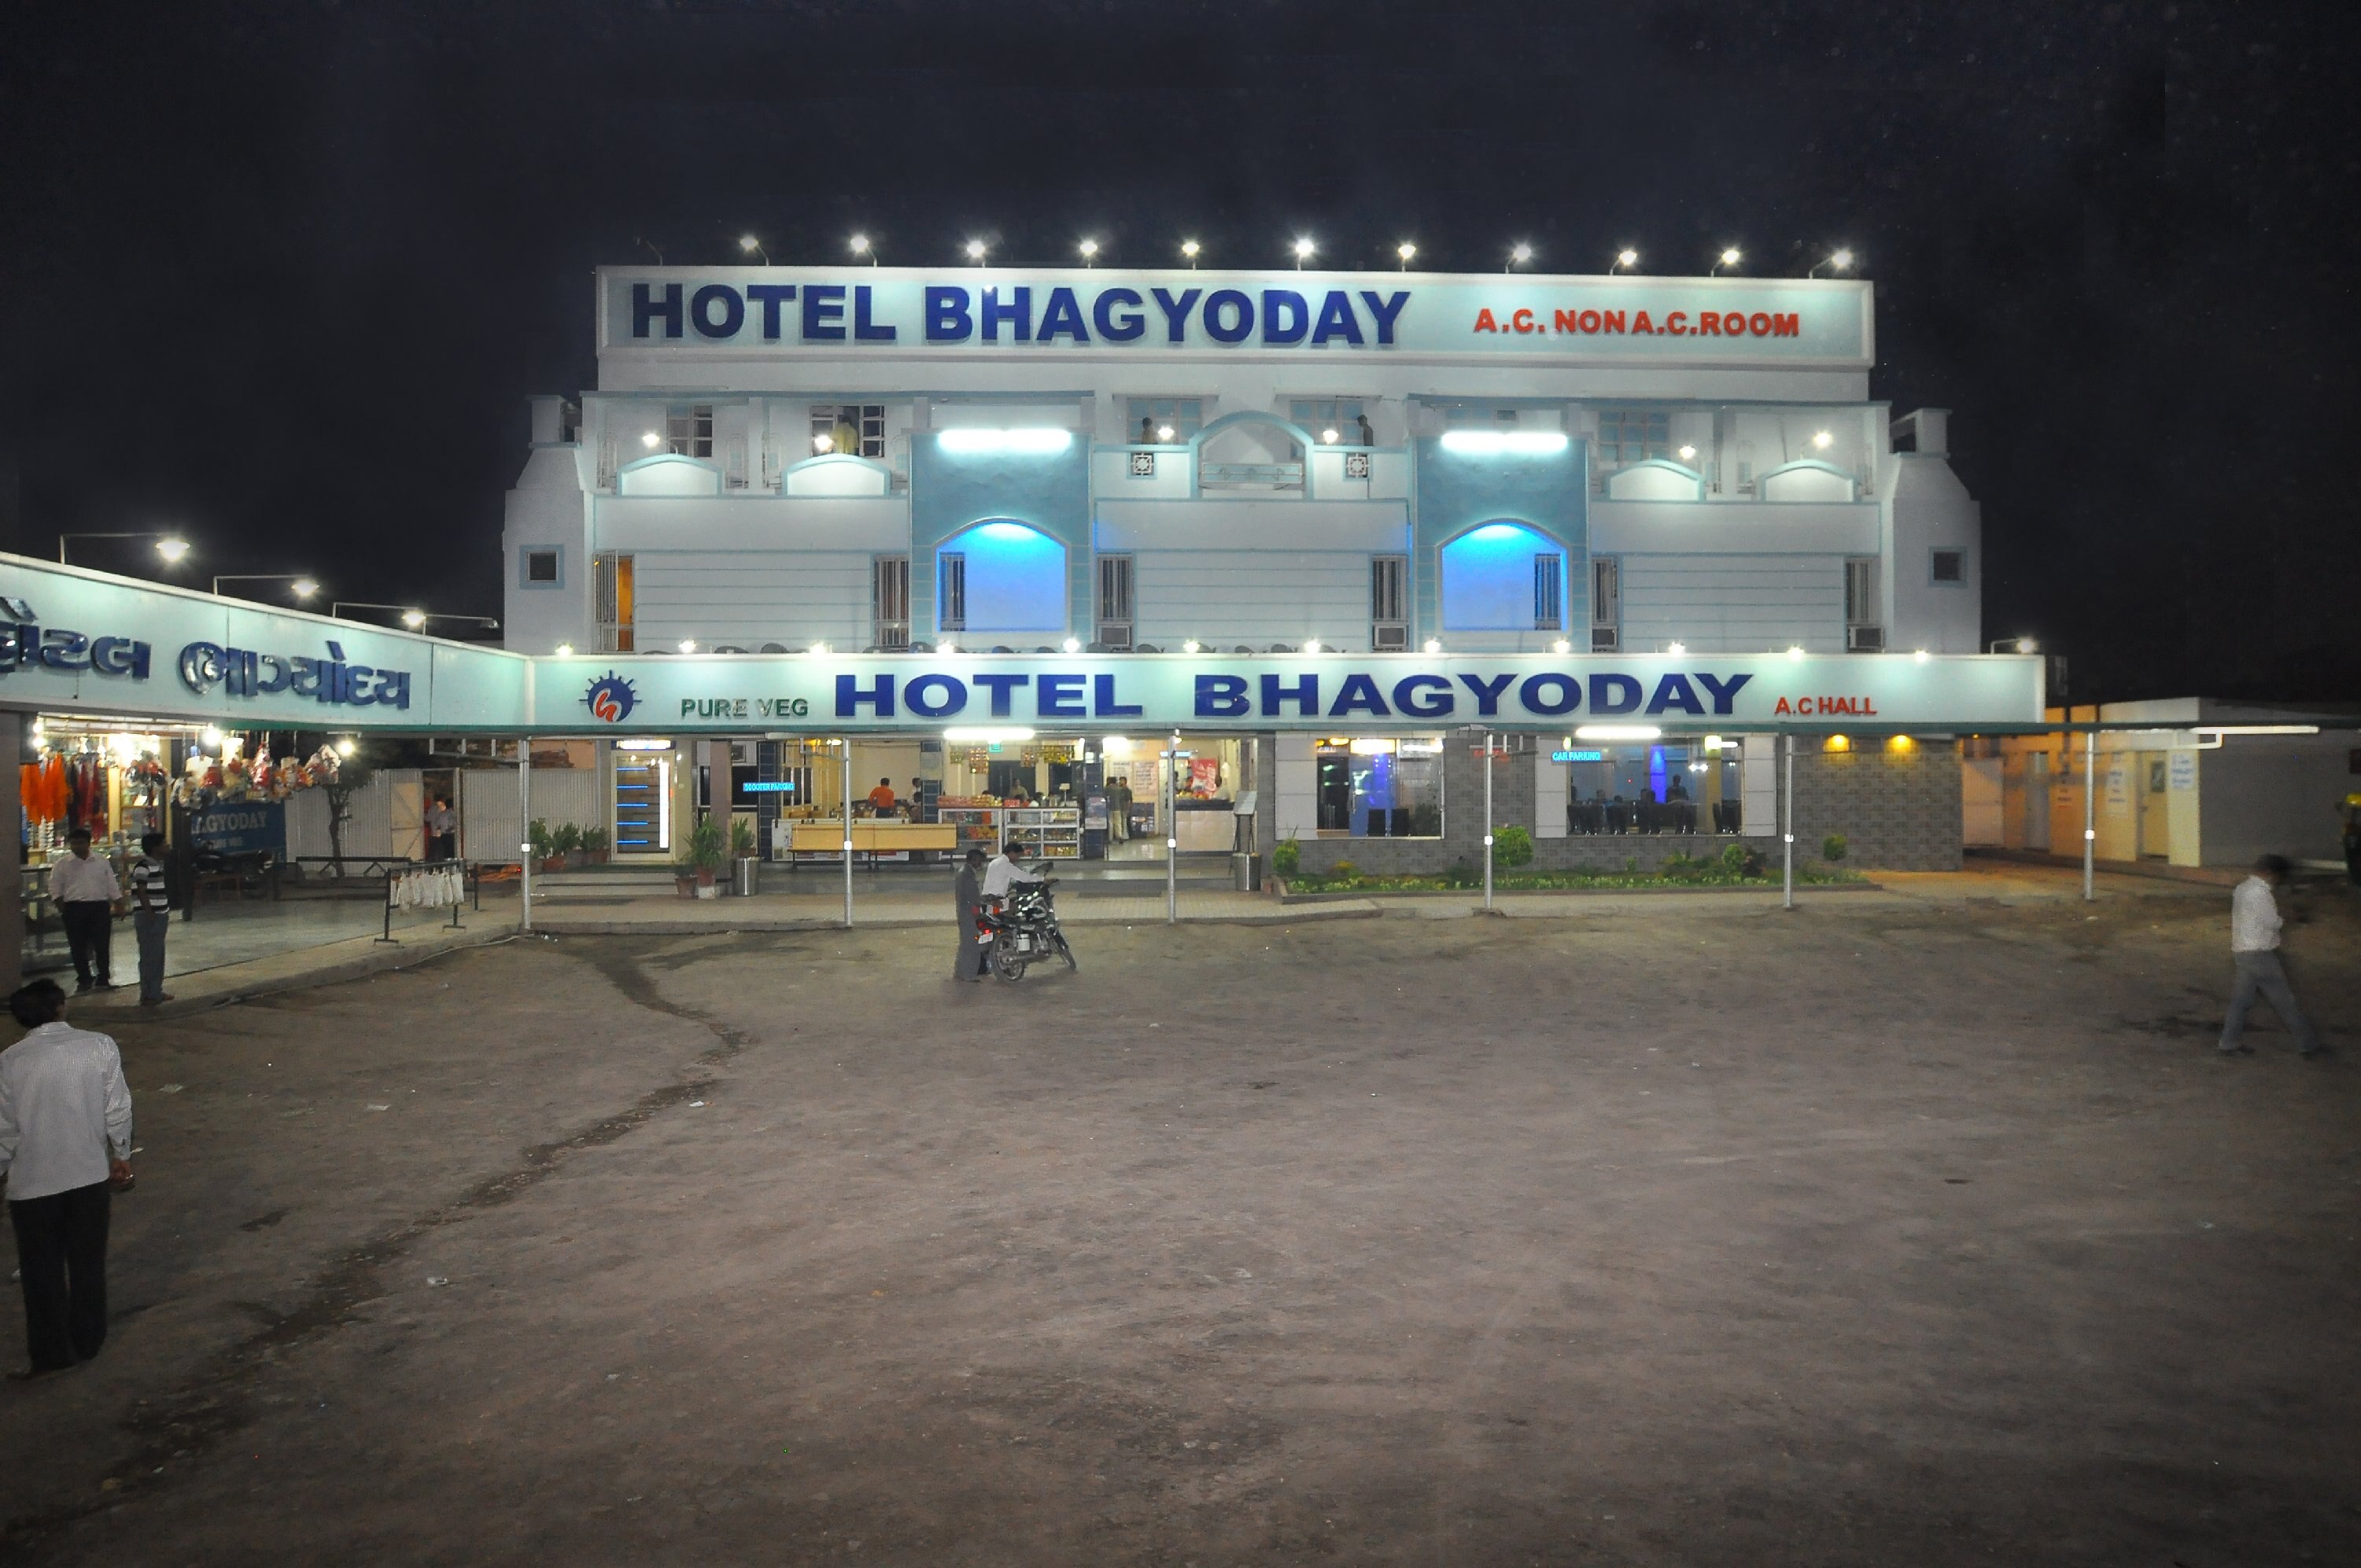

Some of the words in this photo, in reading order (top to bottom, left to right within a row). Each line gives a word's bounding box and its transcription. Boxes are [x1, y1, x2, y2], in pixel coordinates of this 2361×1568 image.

[632, 283, 897, 340] HOTEL
[924, 286, 1411, 345] BHAGYODAY
[1474, 308, 1545, 334] A.C.
[179, 640, 411, 709] ભાગ્યોદય
[681, 699, 747, 718] PURE
[757, 698, 808, 717] VEG
[835, 673, 1143, 718] HOTEL
[1193, 673, 1754, 718] BHAGYODAY
[1818, 696, 1877, 714] HALL
[1552, 751, 1568, 762] CAR
[1569, 751, 1601, 761] PARKING
